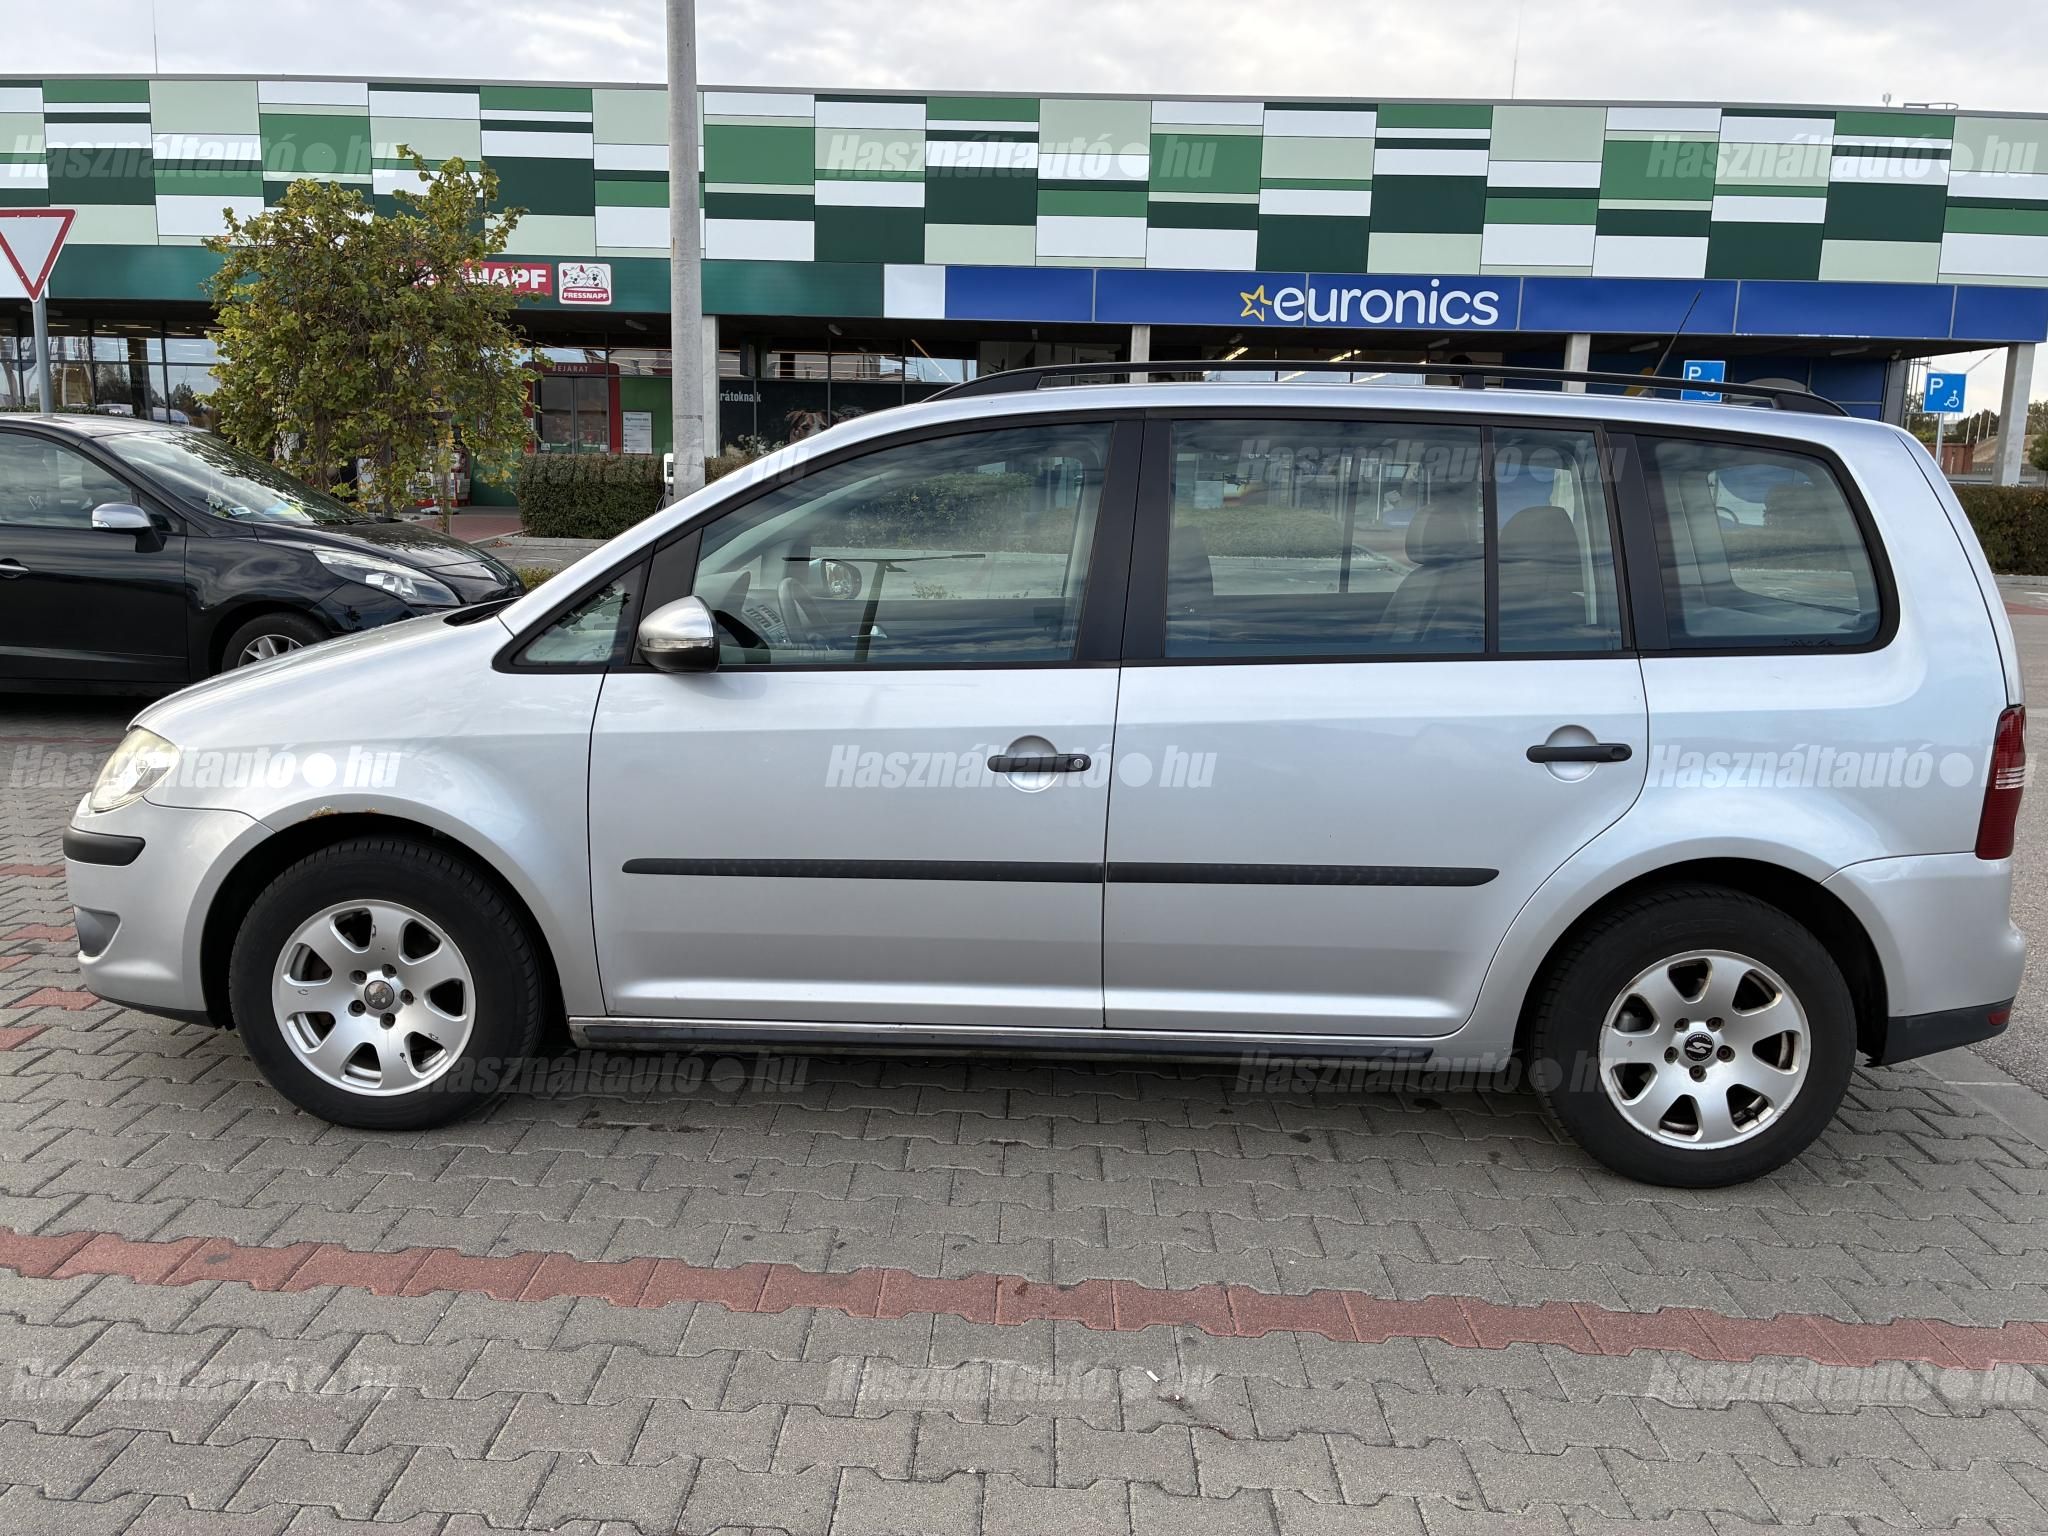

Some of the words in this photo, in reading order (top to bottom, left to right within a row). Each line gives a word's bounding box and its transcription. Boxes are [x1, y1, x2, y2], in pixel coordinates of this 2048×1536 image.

[1273, 278, 1499, 326] euronics
[1688, 366, 1701, 380] P
[1930, 378, 1943, 395] P
